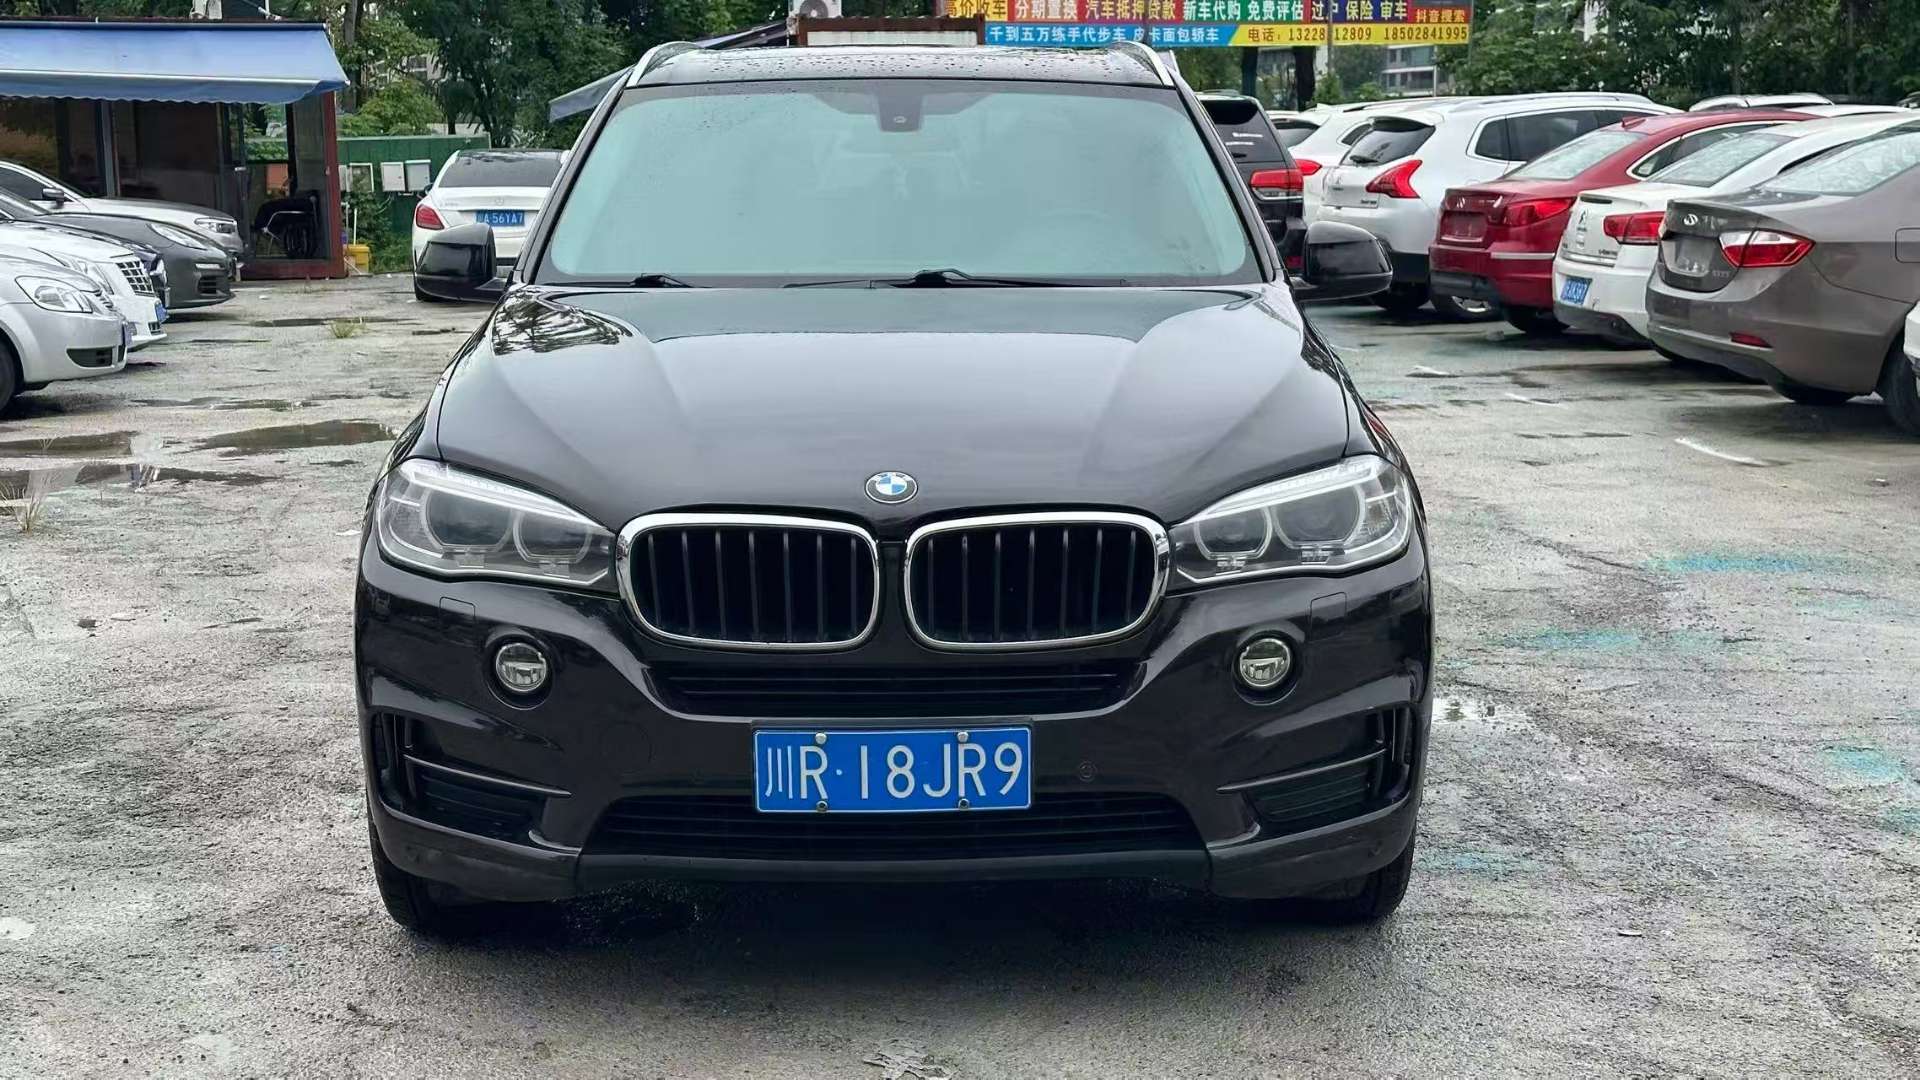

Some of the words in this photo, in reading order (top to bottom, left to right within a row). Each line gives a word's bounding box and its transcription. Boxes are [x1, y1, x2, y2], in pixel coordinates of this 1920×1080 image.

[1014, 0, 1077, 19] 分期置换
[1183, 0, 1241, 20] 新车代购
[1248, 0, 1304, 20] 免费评估
[1346, 0, 1374, 20] 保险
[1380, 0, 1408, 20] 审车
[985, 26, 1126, 42] 千到五万练手代步车
[1289, 27, 1372, 41] 1322812809
[1384, 26, 1467, 40] 18502841995
